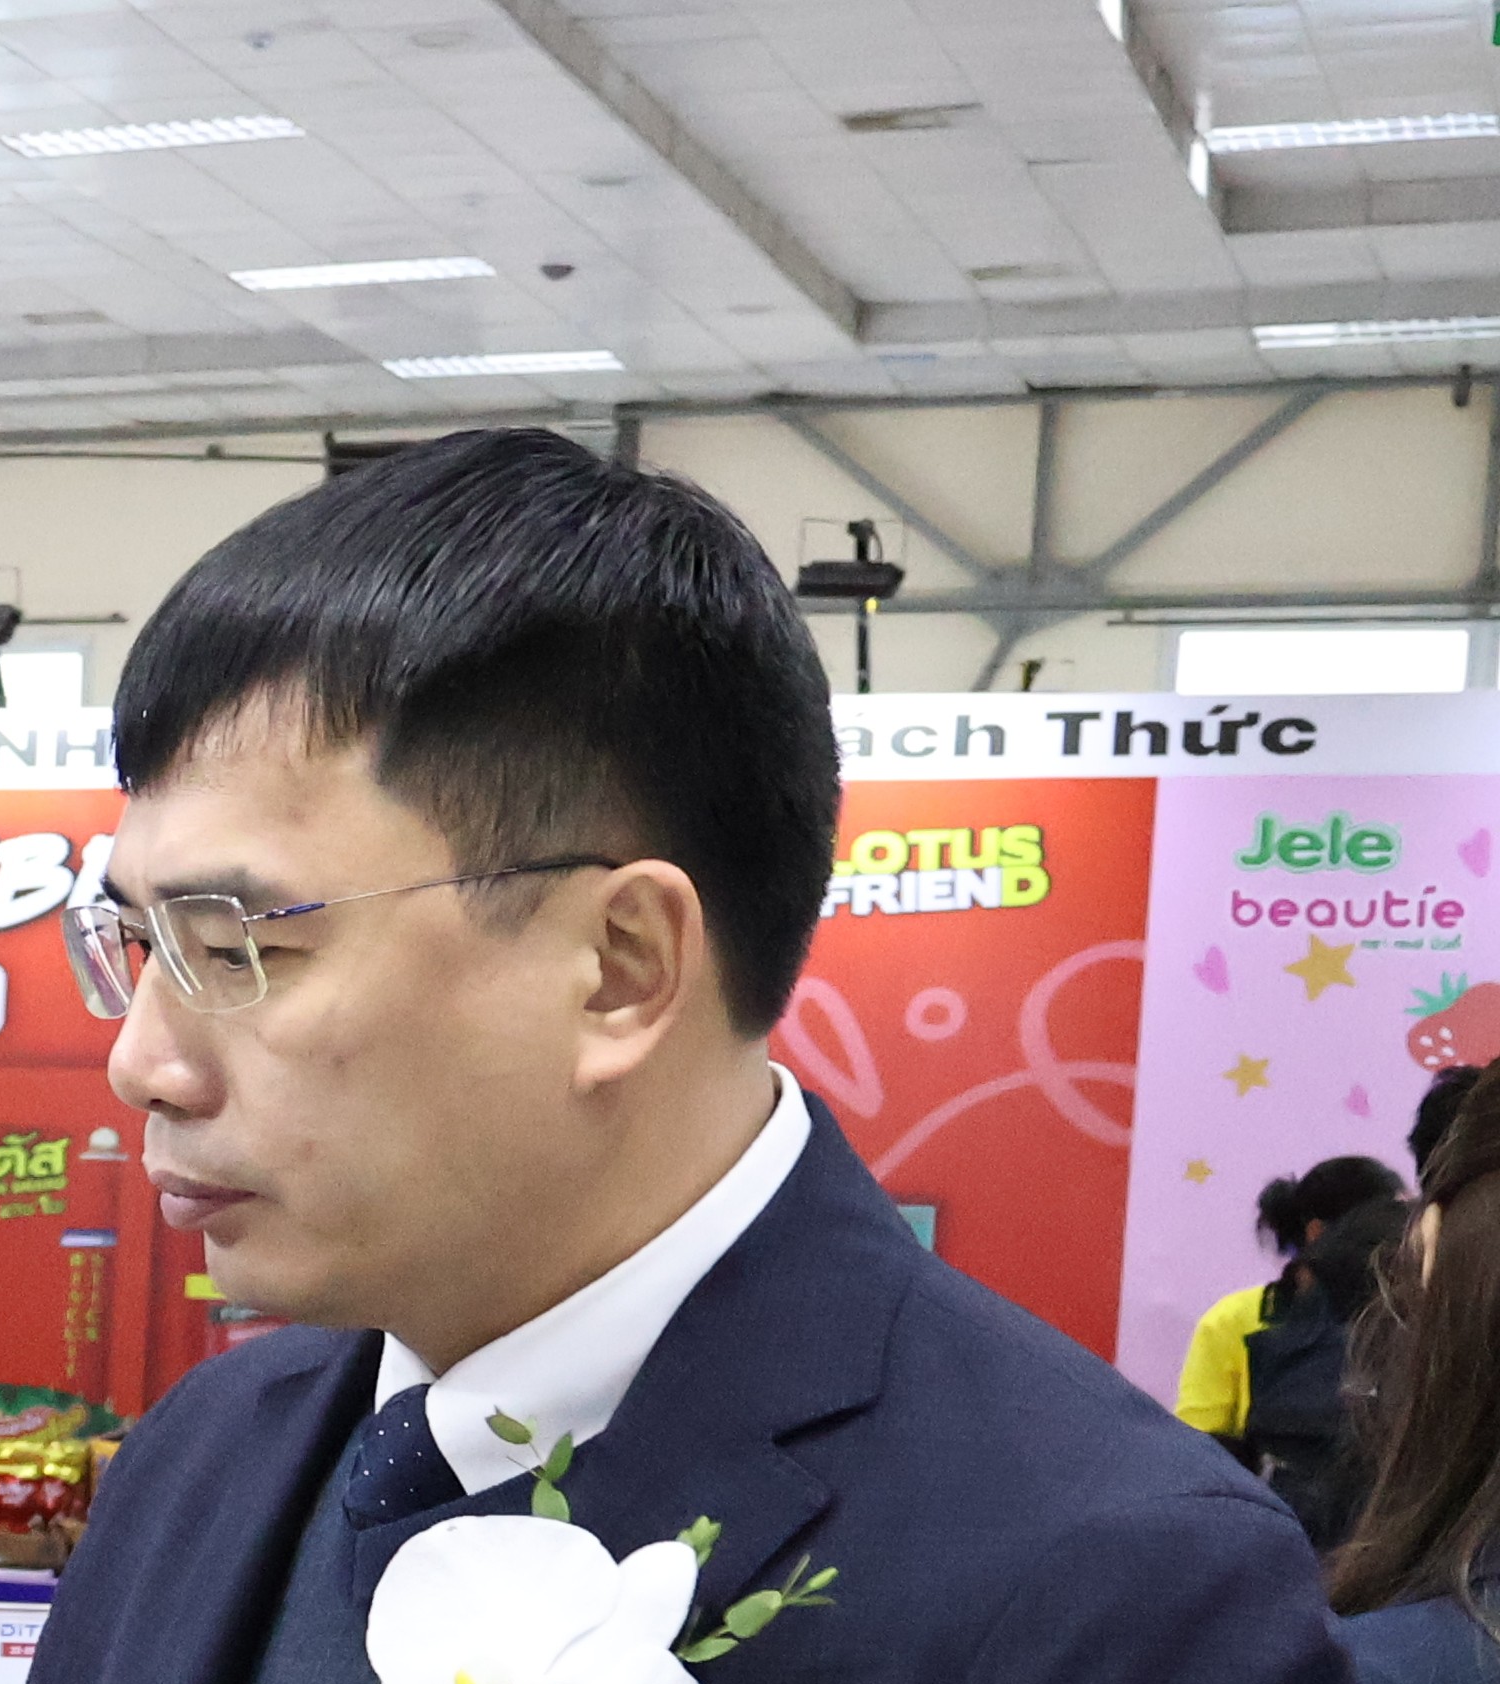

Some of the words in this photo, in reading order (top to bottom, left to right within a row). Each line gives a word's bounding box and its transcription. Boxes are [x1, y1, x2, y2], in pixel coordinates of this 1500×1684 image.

[1046, 705, 1319, 759] Thức
[1236, 812, 1398, 872] Jele
[820, 864, 1051, 918] FRIEND
[1230, 886, 1465, 930] beautie
